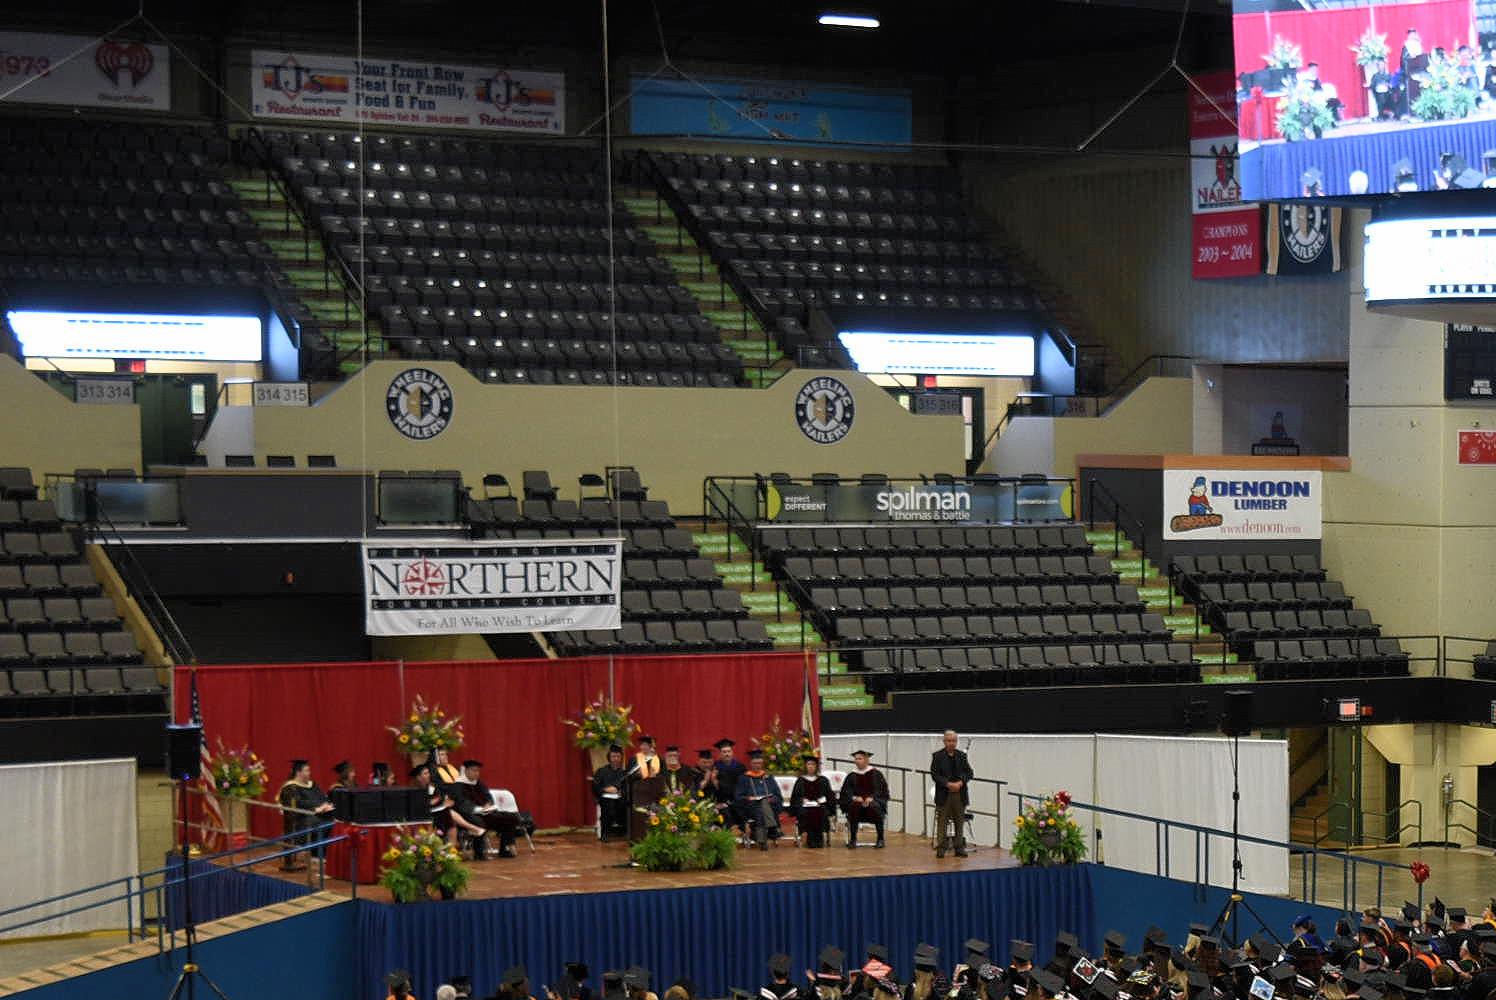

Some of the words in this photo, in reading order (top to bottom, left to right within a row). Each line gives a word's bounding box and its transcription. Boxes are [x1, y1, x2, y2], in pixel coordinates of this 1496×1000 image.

[391, 63, 429, 79] Front
[433, 67, 465, 81] Row
[392, 80, 411, 93] for
[410, 96, 437, 111] Fun
[1198, 187, 1241, 202] NAILE
[1287, 232, 1325, 259] NAILERS
[78, 386, 104, 398] 313
[107, 386, 132, 398] 314
[388, 370, 450, 400] WHEELING
[797, 379, 852, 406] WHEELING
[256, 387, 280, 400] 314
[284, 387, 306, 401] 315
[394, 416, 446, 437] NAILERS
[802, 421, 849, 442] NAILERS
[1211, 481, 1310, 497] DENOON
[876, 486, 971, 519] spilman
[1234, 499, 1288, 511] LUMBER
[895, 510, 932, 520] thomas
[933, 510, 941, 520] &
[1220, 518, 1302, 535] www.denoon.com
[473, 546, 617, 557] VIRGINIA
[373, 598, 503, 610] COMMUNITY
[522, 595, 616, 607] COLLEGE
[417, 618, 438, 629] For
[440, 617, 458, 629] All
[462, 616, 489, 627] Who
[491, 615, 522, 627] Wish
[526, 616, 542, 627] To
[544, 614, 575, 626] Learn
